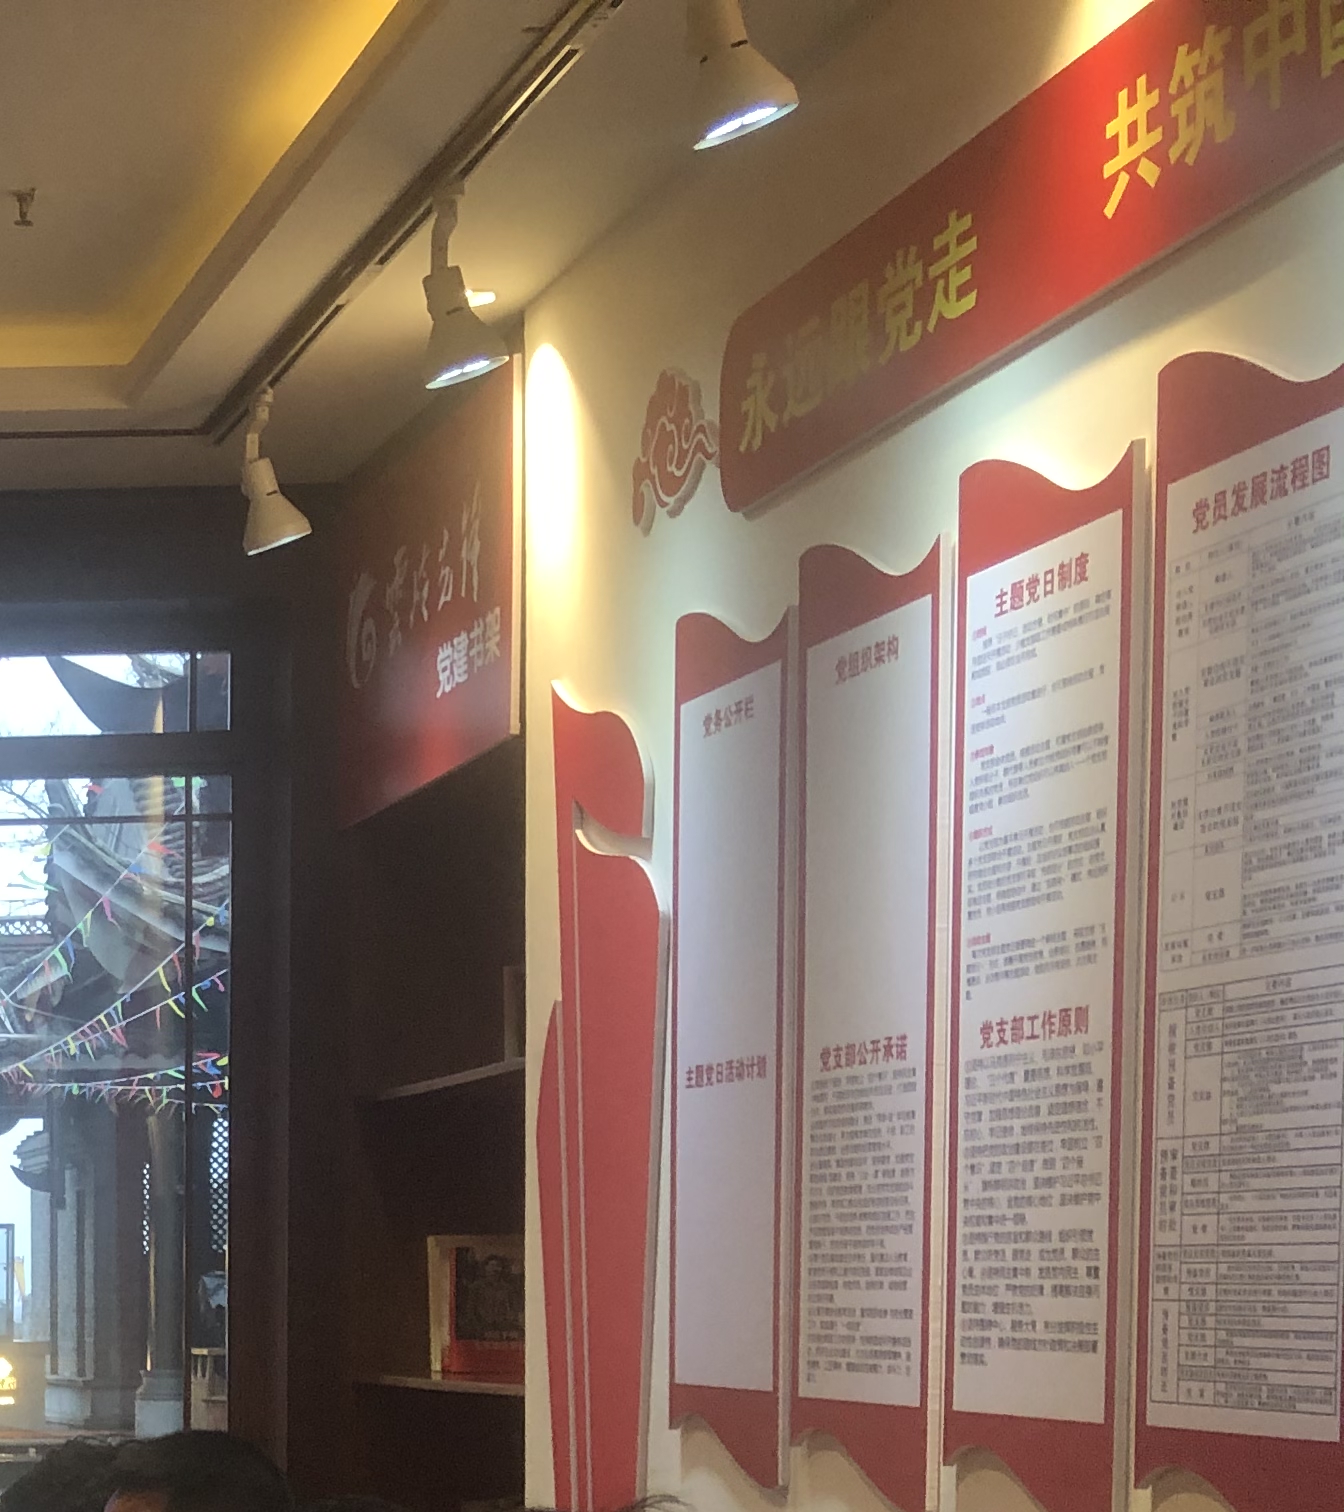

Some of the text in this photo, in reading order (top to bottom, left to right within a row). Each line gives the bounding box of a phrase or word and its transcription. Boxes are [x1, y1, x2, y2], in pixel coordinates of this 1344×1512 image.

[737, 208, 979, 455] 永远跟党走
[1192, 444, 1331, 535] 党员发展流程图
[993, 551, 1090, 618] 主题党日制度
[435, 606, 501, 699] 党建书架
[834, 634, 900, 687] 党组织架构
[819, 1033, 908, 1073] 党支部公开承诺
[979, 1004, 1089, 1050] 党支部工作原则
[684, 1054, 768, 1090] 主题党日活动计划
